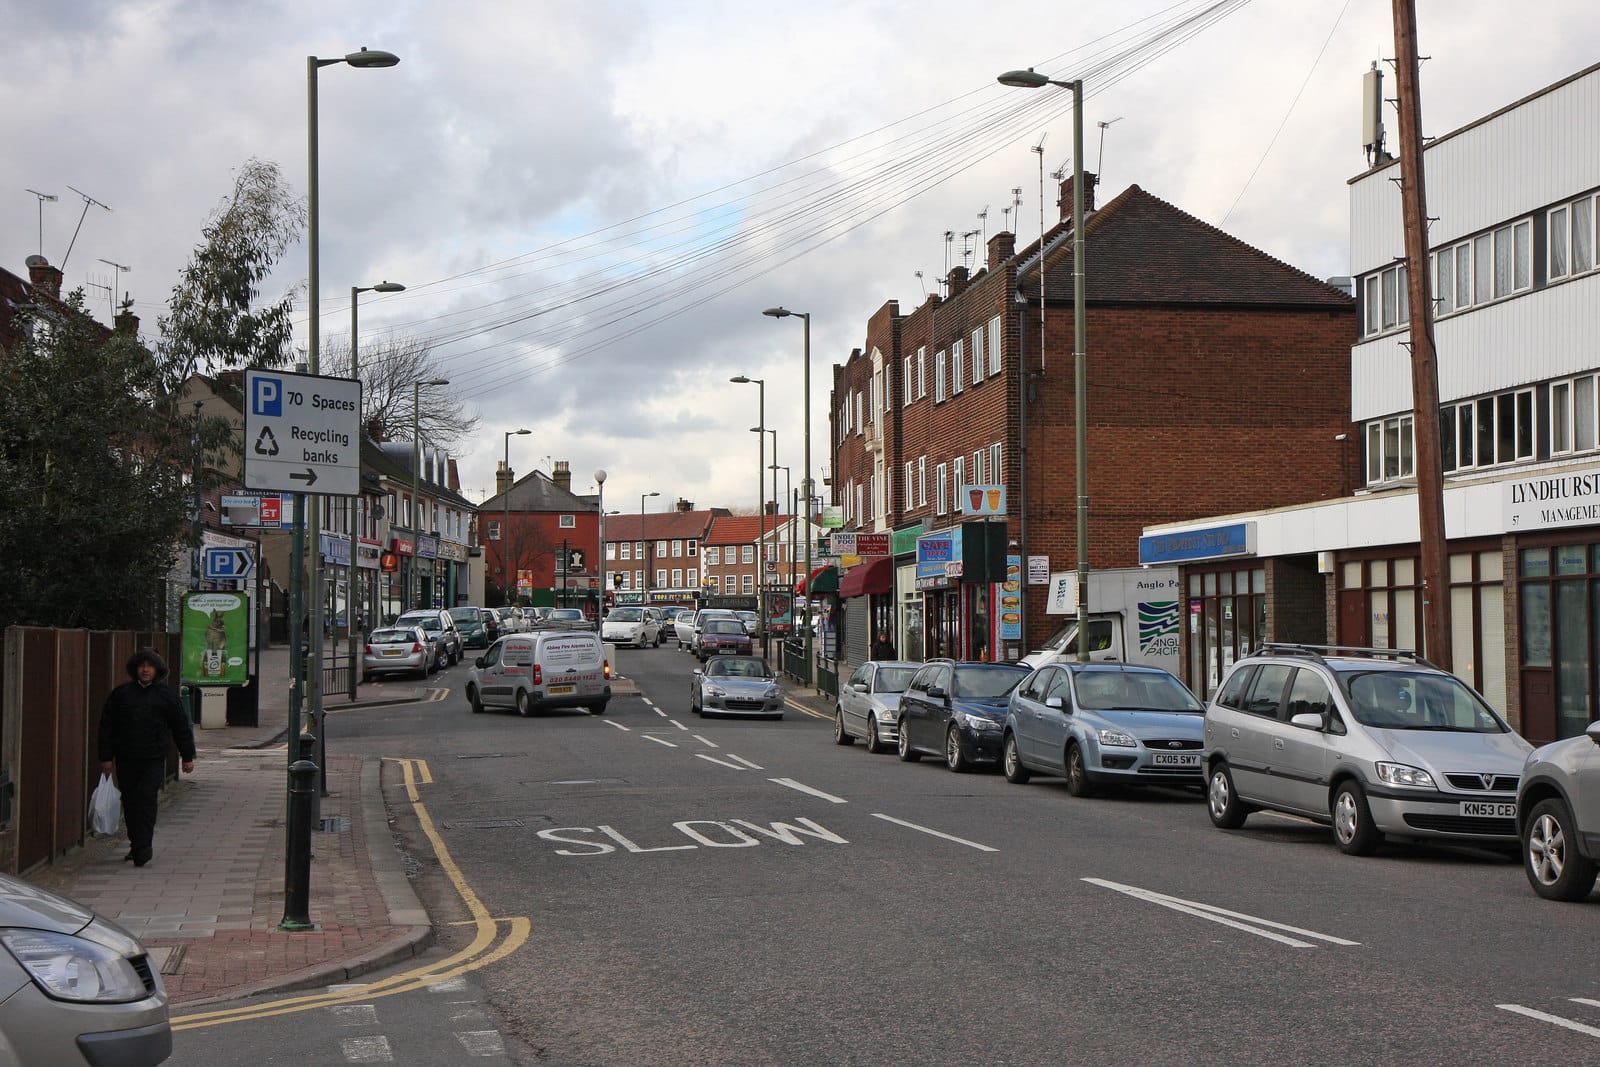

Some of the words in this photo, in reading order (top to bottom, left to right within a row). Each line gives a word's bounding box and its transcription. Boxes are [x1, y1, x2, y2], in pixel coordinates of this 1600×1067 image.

[258, 381, 277, 412] P
[287, 391, 303, 406] 70
[312, 394, 355, 411] Spaces
[291, 426, 349, 447] Recycling
[303, 448, 338, 463] banks
[1512, 473, 1600, 504] LYNDHURST
[1512, 515, 1520, 526] 57
[1541, 504, 1600, 523] MANAGEME
[921, 541, 950, 550] CAFE
[215, 555, 230, 572] P
[1137, 580, 1164, 590] Anglo
[1156, 755, 1178, 764] CX05
[1180, 755, 1197, 764] SWY
[1464, 803, 1494, 815] KN53
[536, 817, 849, 856] SLOW
